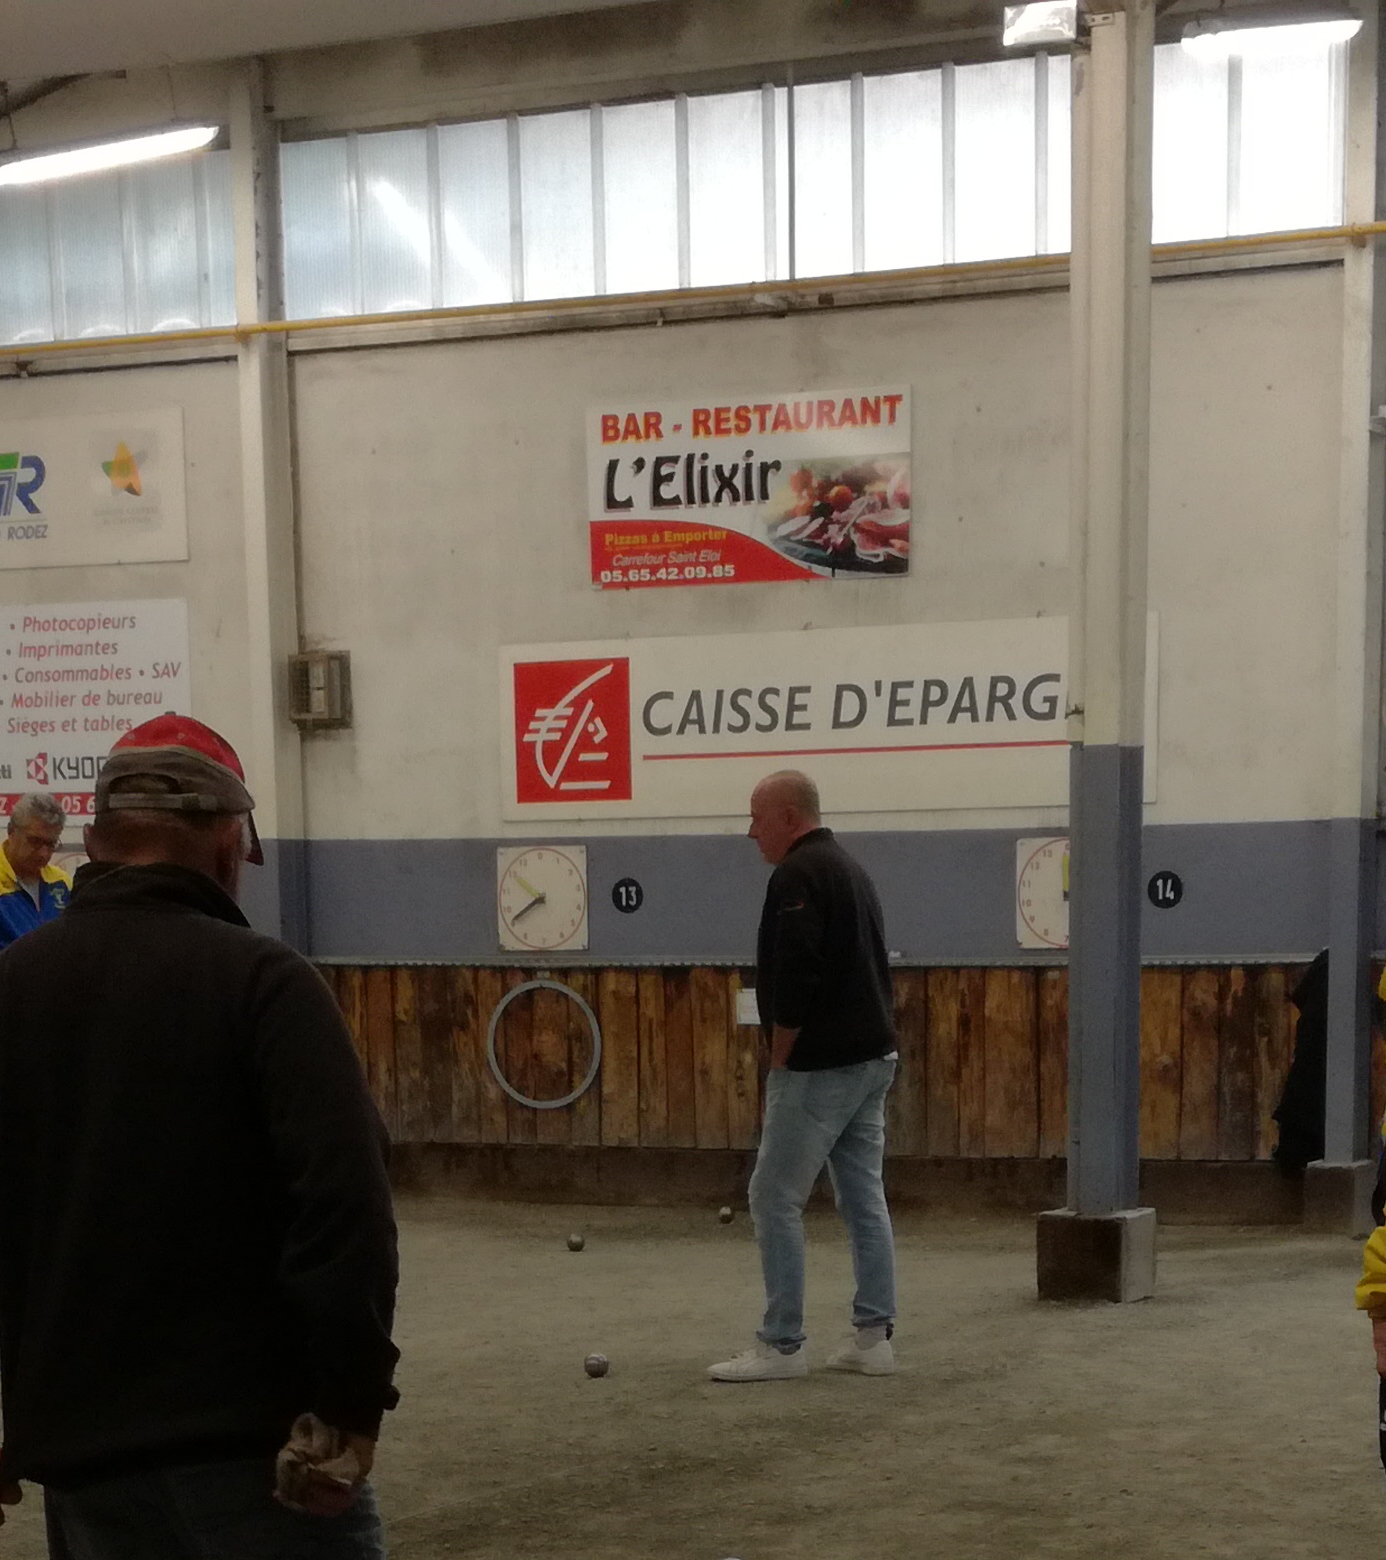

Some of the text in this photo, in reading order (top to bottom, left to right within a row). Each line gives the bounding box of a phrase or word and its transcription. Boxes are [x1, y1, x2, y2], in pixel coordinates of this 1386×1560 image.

[601, 411, 664, 445] BAR
[692, 393, 904, 439] RESTAURANT
[603, 448, 783, 513] L'Elixir
[7, 524, 49, 540] RODEZ
[604, 533, 648, 546] Pizzas
[664, 529, 728, 544] Emporter
[612, 553, 665, 567] Carrefour
[667, 550, 697, 564] Saint
[600, 564, 735, 583] 05.65.42.09.85
[22, 613, 136, 634] Photocopieurs
[18, 640, 119, 662] Imprimantes
[14, 661, 181, 684] Consommables SAV
[10, 689, 163, 708] Mobilier de bureau
[641, 672, 1065, 738] CAISSE D'EPARG
[61, 717, 77, 732] et
[83, 715, 133, 732] tables
[61, 795, 81, 813] 05
[619, 885, 637, 907] 13
[1156, 878, 1175, 900] 14
